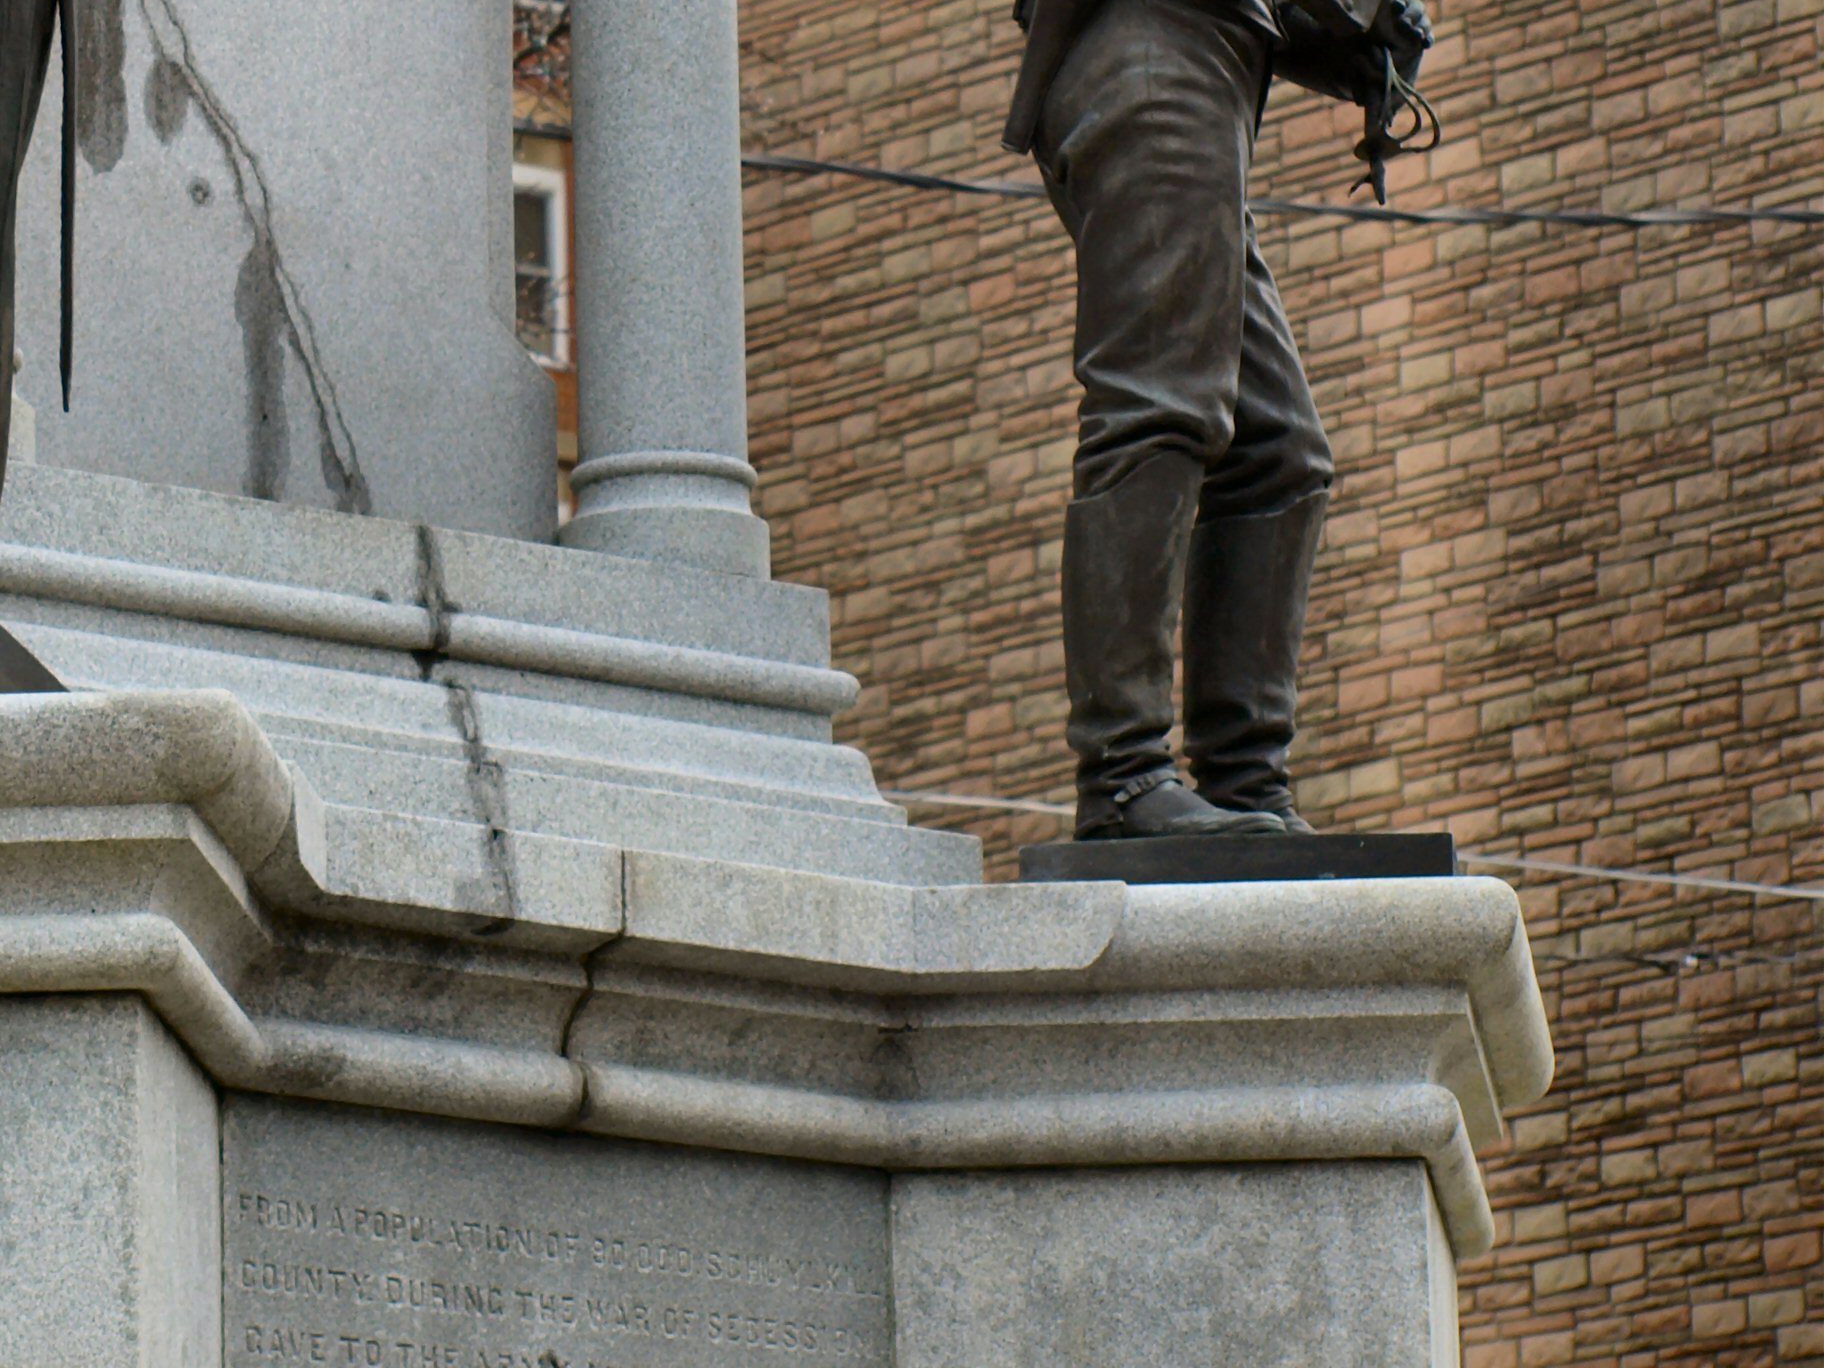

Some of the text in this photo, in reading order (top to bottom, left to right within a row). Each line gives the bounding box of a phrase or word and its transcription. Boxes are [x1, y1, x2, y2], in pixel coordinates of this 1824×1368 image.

[239, 1193, 318, 1231] FROM
[354, 1208, 532, 1258] POPULATION
[545, 1232, 579, 1263] OF
[385, 1275, 504, 1317] DURING
[514, 1289, 576, 1325] THE
[586, 1296, 651, 1334] WAR
[663, 1307, 695, 1338] OF
[245, 1324, 325, 1362] GAVE
[339, 1336, 382, 1367] TO
